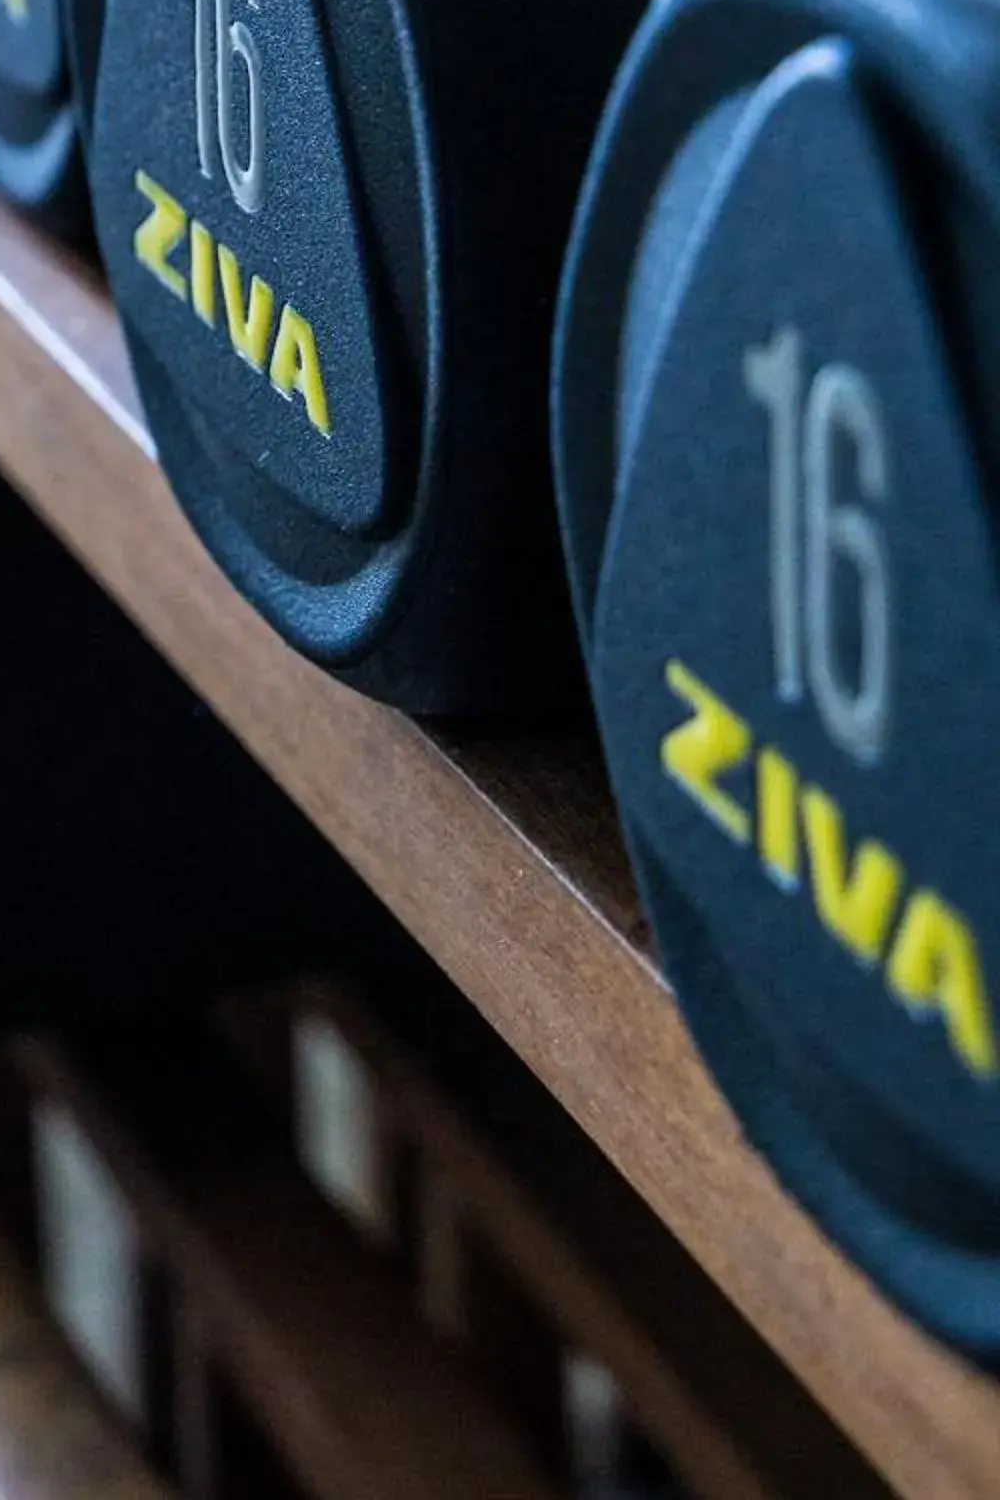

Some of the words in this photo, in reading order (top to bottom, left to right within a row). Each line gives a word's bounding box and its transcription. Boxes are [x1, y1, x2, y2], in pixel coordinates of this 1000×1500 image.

[135, 169, 331, 438] ZIVA
[744, 326, 889, 766] 16
[661, 657, 998, 1078] ZIVA
